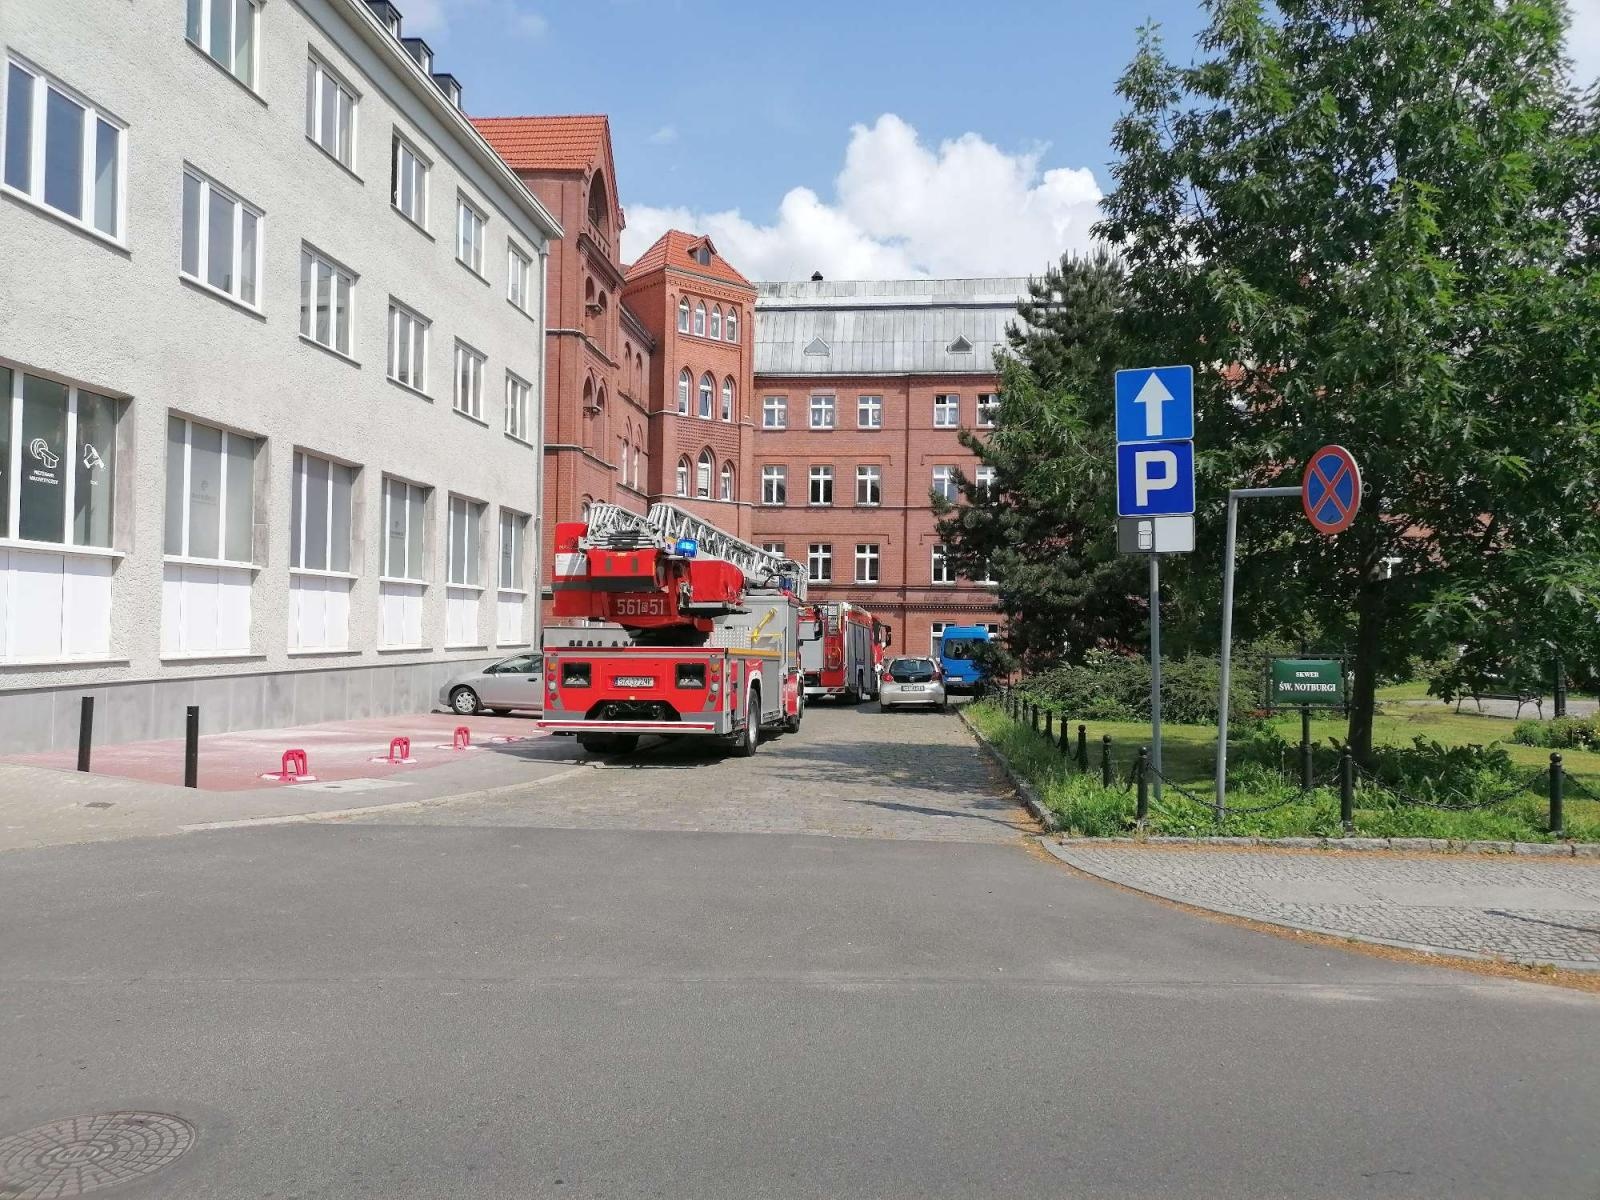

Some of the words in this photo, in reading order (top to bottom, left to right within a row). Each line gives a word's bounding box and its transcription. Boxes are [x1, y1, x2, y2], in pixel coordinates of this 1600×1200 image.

[1135, 450, 1178, 507] P
[1279, 681, 1294, 692] ŚW.
[1294, 683, 1336, 692] NOTBURGI
